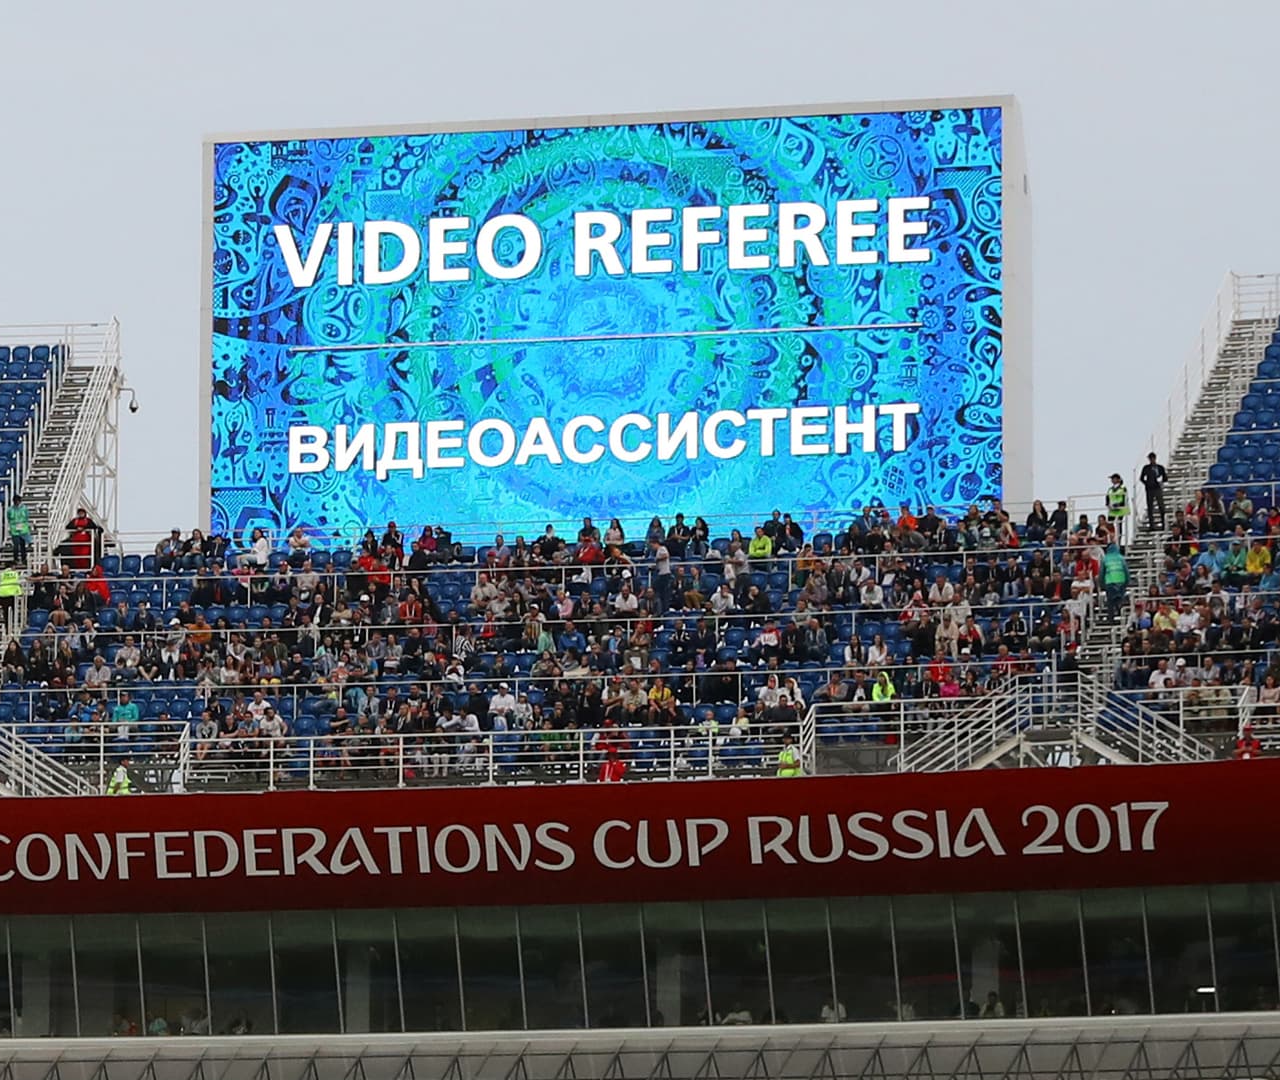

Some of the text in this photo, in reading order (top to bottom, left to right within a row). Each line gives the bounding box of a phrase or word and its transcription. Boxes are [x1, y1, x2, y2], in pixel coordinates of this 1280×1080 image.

[273, 196, 930, 288] VIDEO REFEREE
[288, 403, 920, 480] ВИДЕОАССИСТЕНТ
[593, 818, 730, 869] CUP
[747, 807, 1006, 864] RUSSIA
[1021, 801, 1169, 855] 2017
